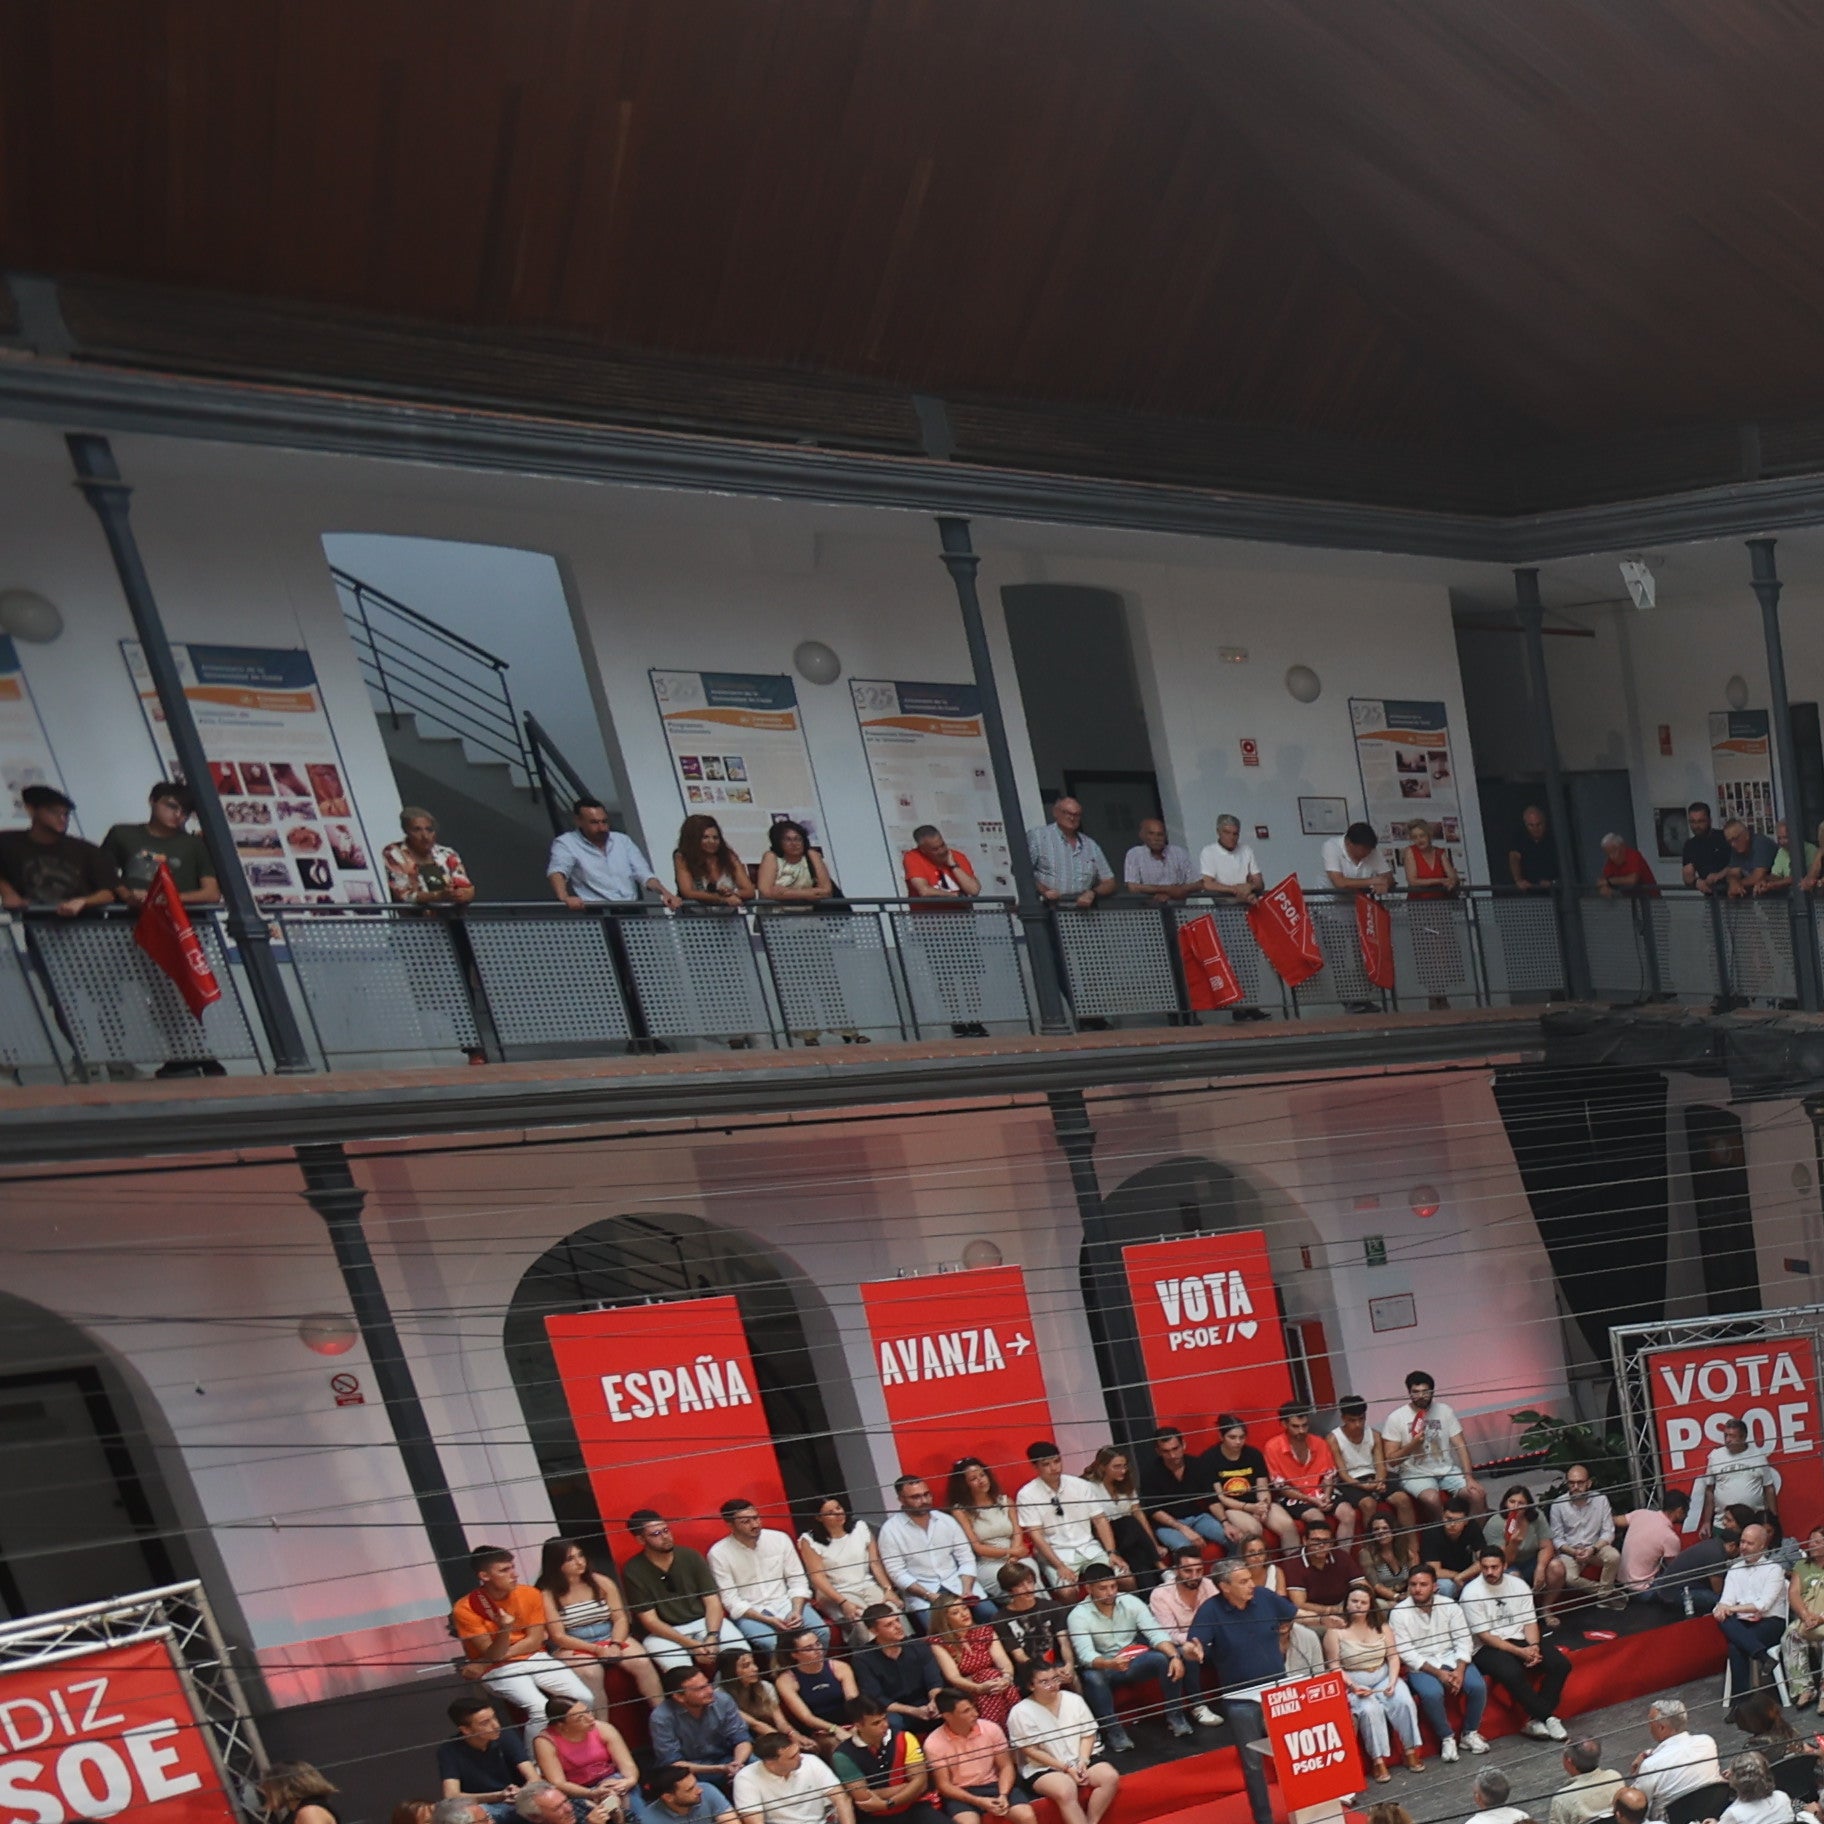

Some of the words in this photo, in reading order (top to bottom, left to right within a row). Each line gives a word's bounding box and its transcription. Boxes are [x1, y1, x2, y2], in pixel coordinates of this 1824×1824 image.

[1274, 891, 1301, 926] PSOE
[1155, 1270, 1254, 1326] VOTA
[1169, 1324, 1222, 1351] PSOE
[881, 1328, 1006, 1386] AVANZA
[601, 1354, 753, 1422] ESPAÑA
[1659, 1352, 1806, 1406] VOTA
[1268, 1686, 1299, 1706] ESPAÑA
[1270, 1700, 1302, 1719] AVANZA
[0, 1677, 125, 1755] DIZ
[1284, 1722, 1342, 1760] VOTA
[1292, 1756, 1324, 1775] PSOE
